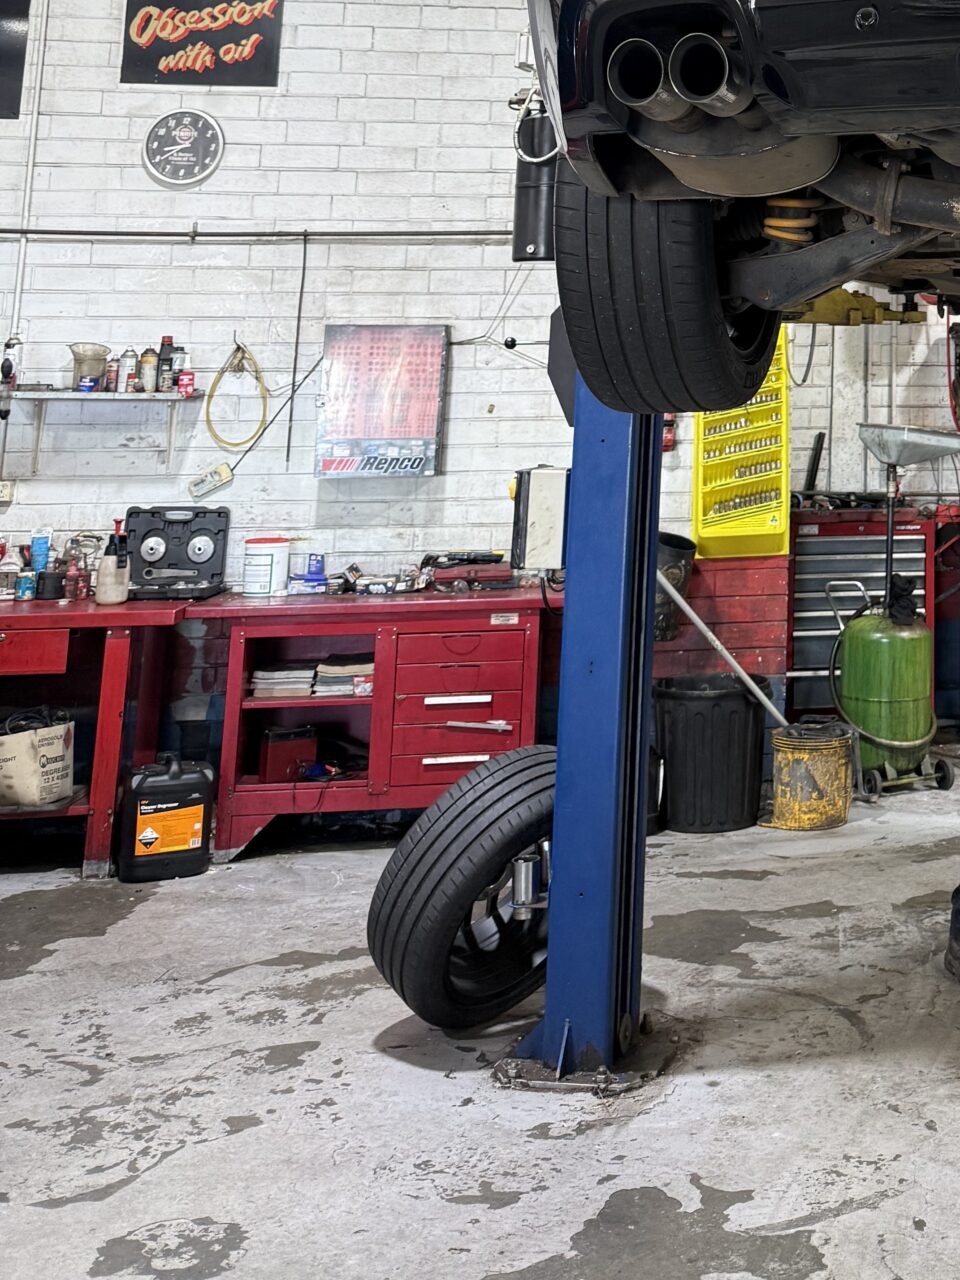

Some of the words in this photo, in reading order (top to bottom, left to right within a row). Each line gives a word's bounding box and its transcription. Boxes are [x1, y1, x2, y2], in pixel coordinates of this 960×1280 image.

[158, 41, 215, 73] with
[219, 33, 263, 64] oil
[361, 455, 425, 474] Repco
